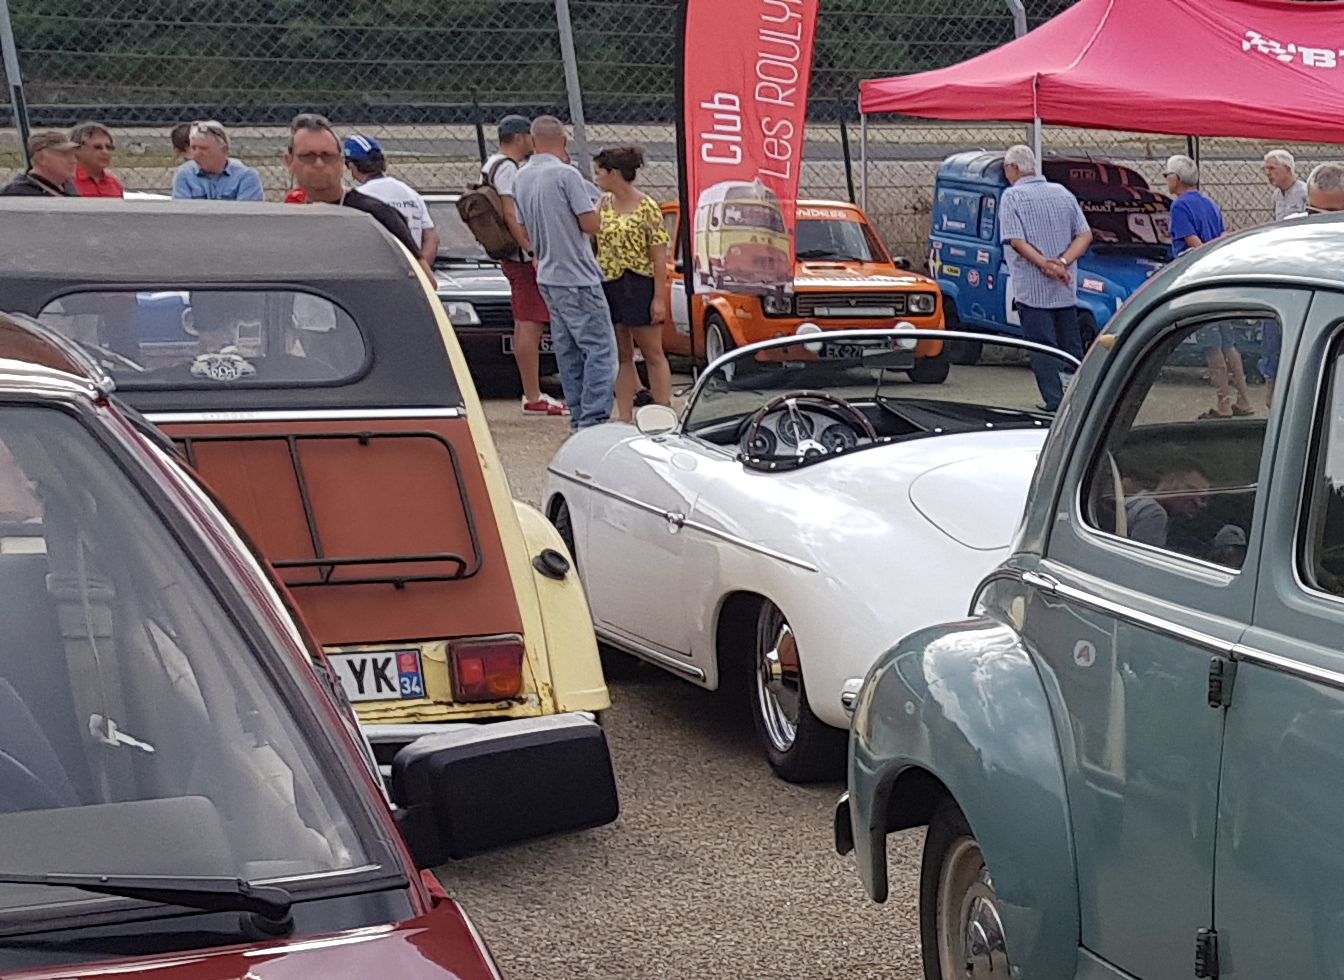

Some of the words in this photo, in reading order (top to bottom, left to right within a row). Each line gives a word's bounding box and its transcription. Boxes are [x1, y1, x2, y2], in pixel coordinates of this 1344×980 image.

[755, 0, 803, 107] ROULY
[701, 92, 742, 165] Club
[400, 677, 421, 695] 34
